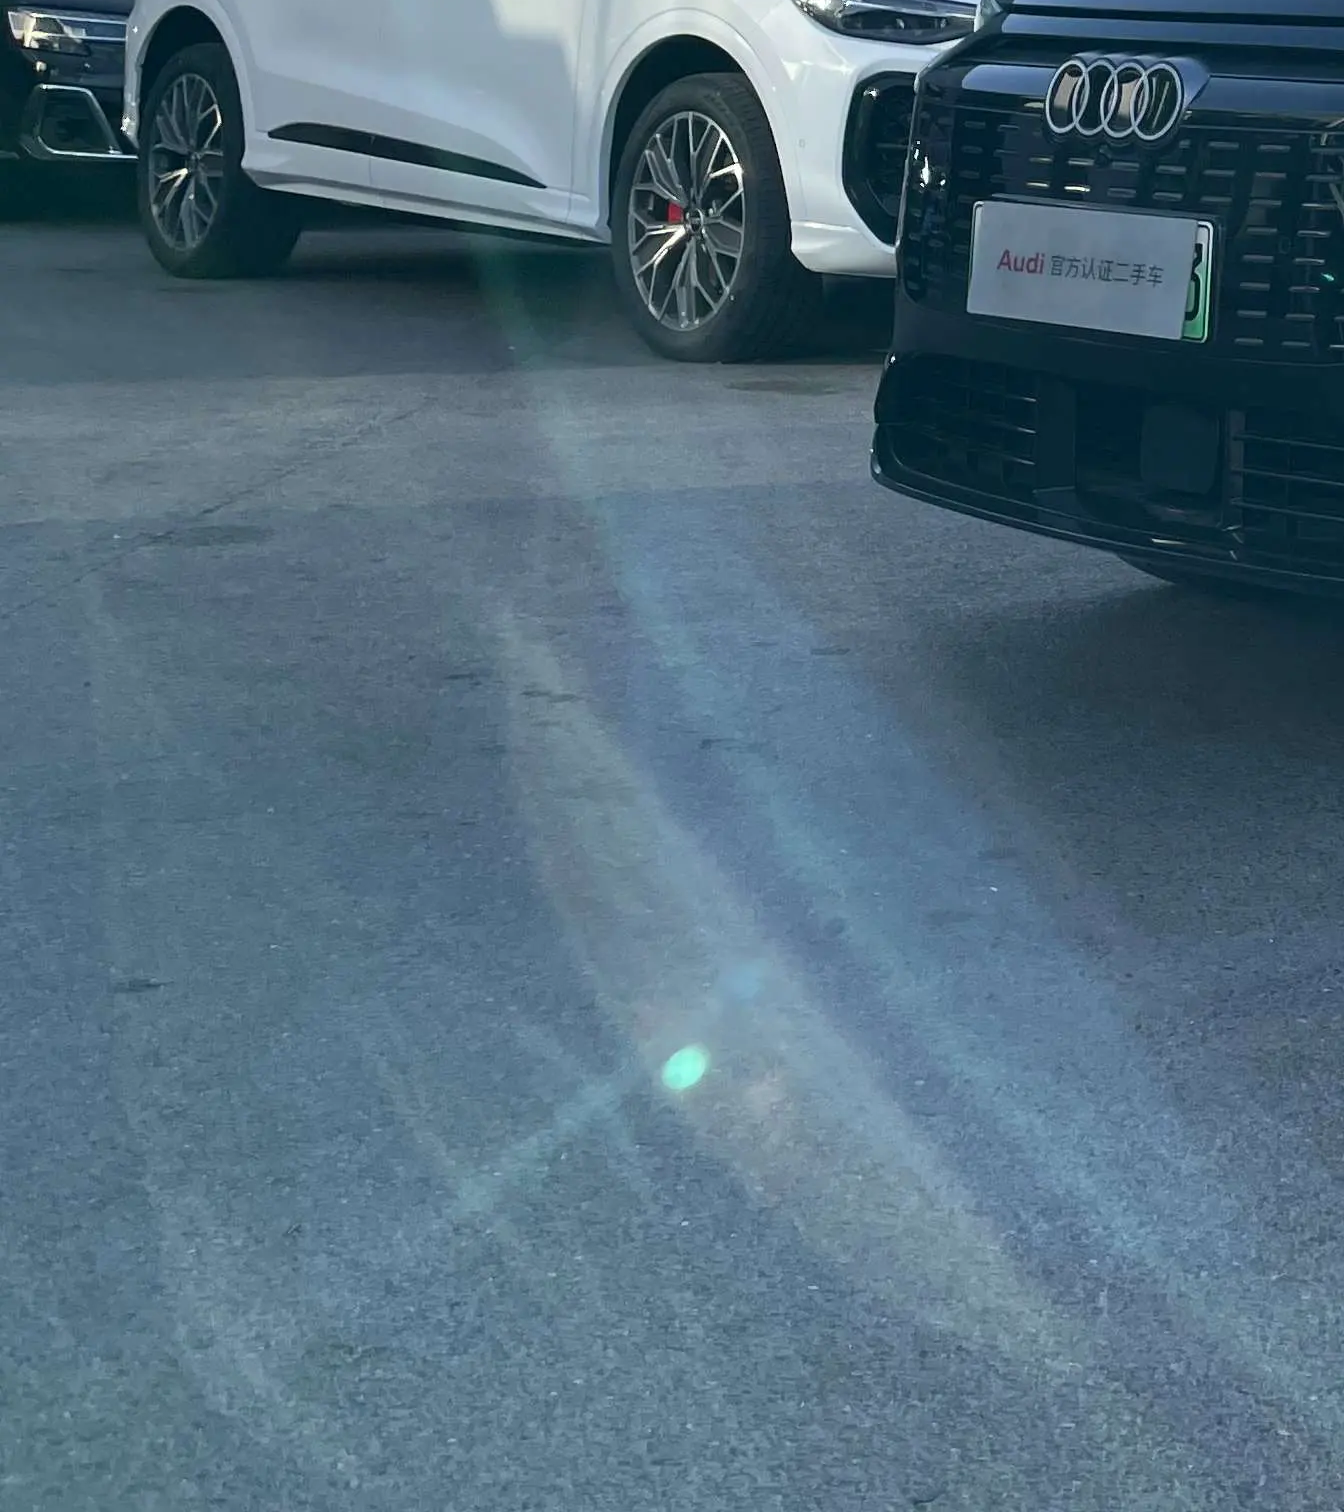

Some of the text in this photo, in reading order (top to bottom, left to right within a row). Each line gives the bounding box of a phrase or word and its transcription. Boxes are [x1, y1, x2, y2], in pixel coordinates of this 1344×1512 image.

[997, 249, 1164, 287] Audi 官方认证二手车
